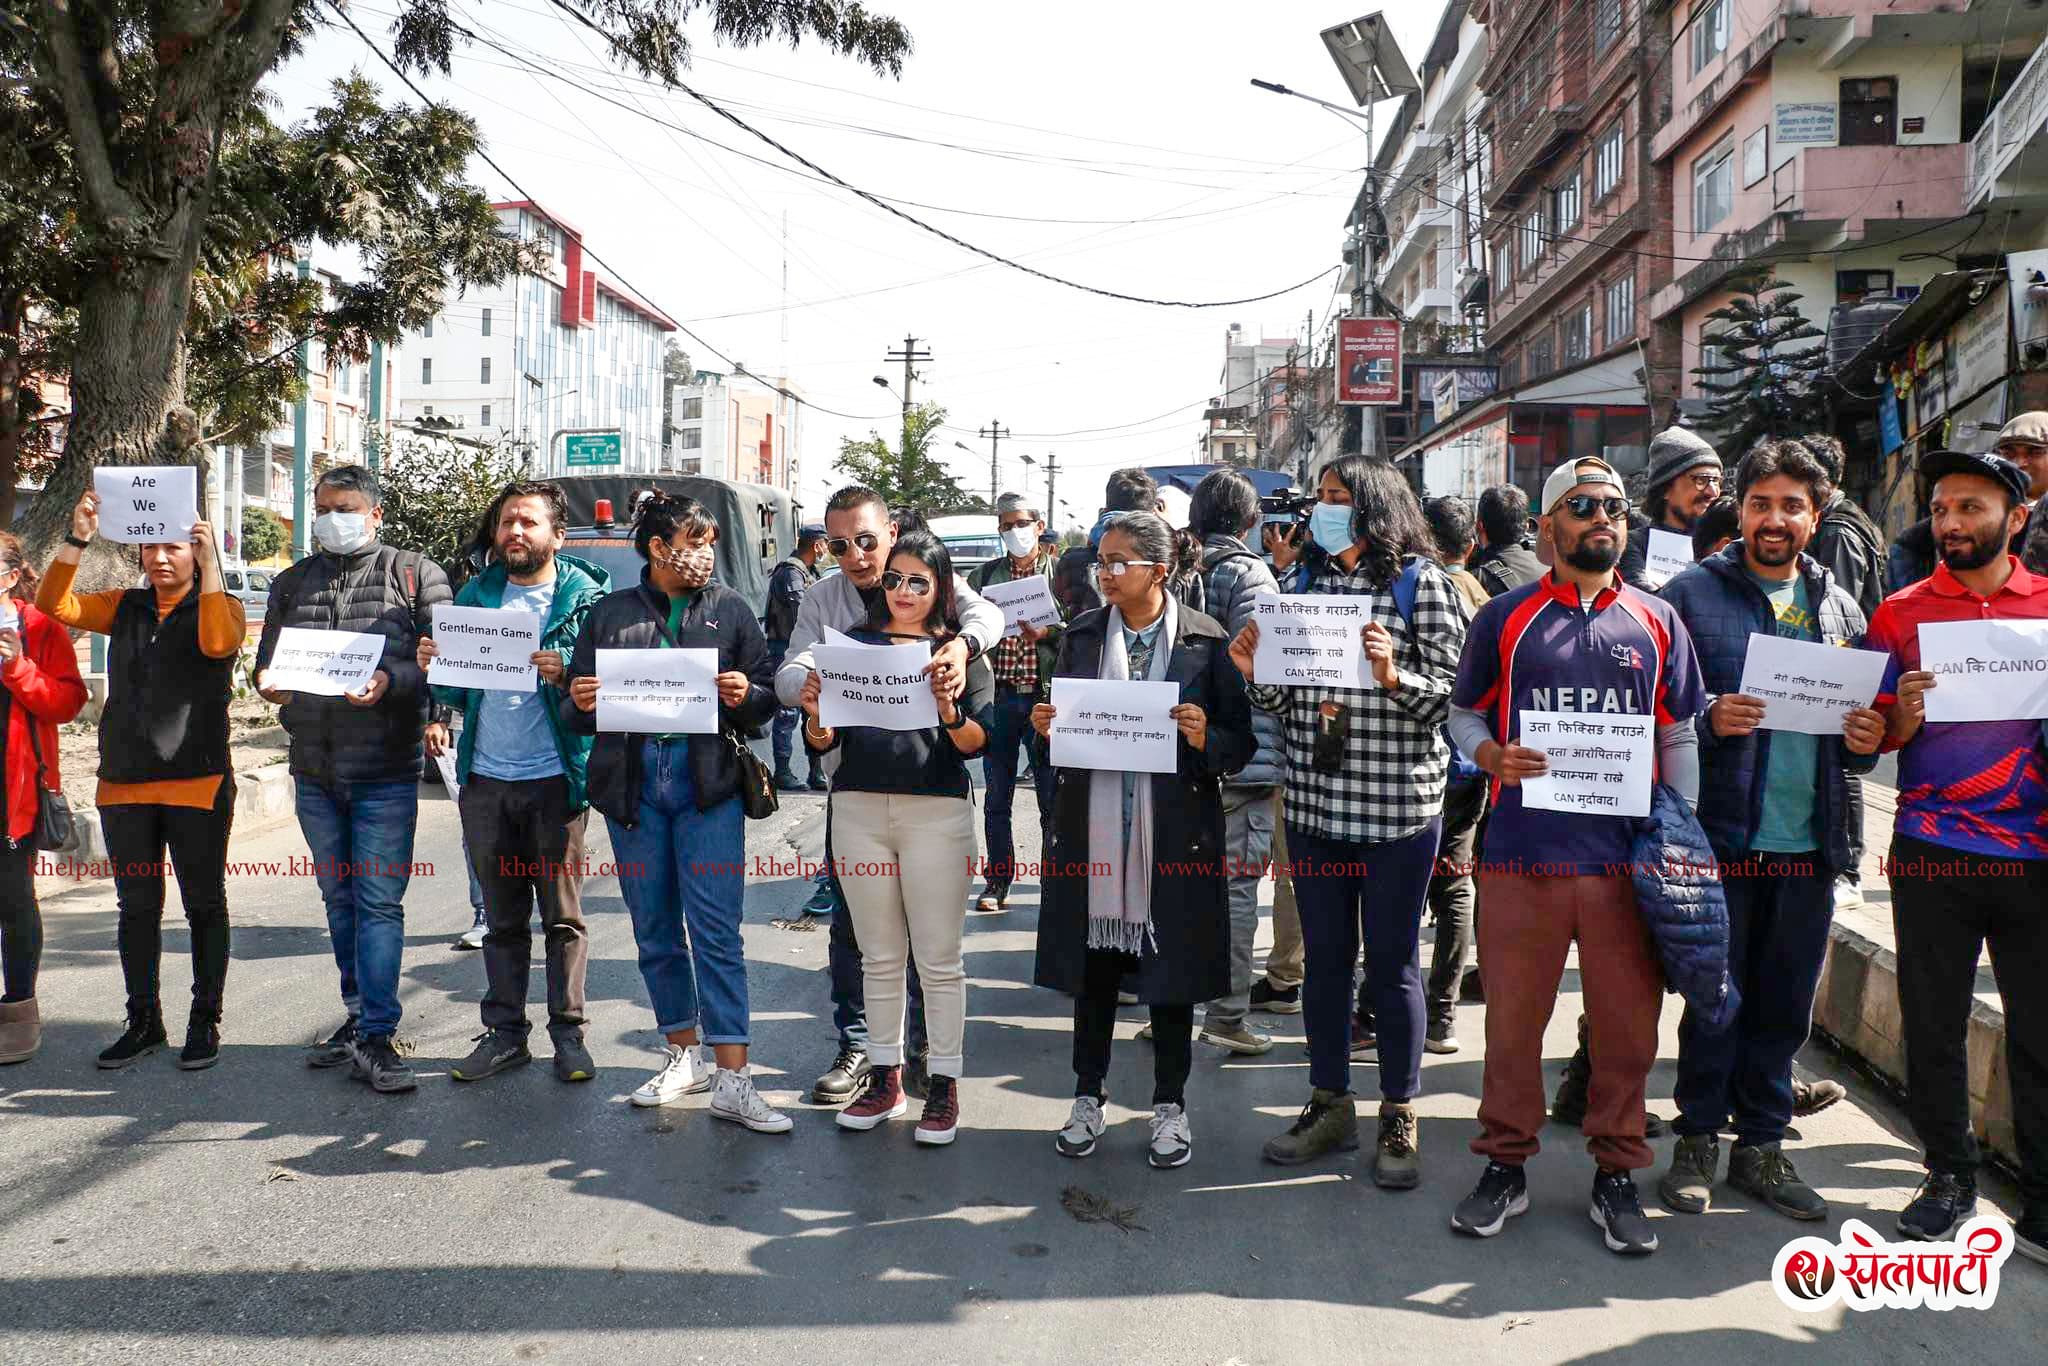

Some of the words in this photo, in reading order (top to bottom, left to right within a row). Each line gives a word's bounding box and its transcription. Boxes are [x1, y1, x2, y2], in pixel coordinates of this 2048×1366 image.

[132, 476, 156, 488] Are
[133, 499, 156, 511] We
[127, 523, 154, 535] safe
[159, 523, 165, 535] ?
[1025, 591, 1045, 602] Game
[1259, 604, 1275, 615] उता
[1030, 614, 1050, 623] Game
[439, 622, 498, 636] Gentleman
[501, 627, 533, 639] Game
[1274, 627, 1291, 636] यता
[1296, 626, 1347, 638] आरोपितलाई
[480, 646, 491, 654] or
[436, 657, 493, 672] Mentalman
[496, 663, 525, 674] Game
[1932, 663, 1963, 674] CAN
[1966, 658, 1987, 673] कि
[1988, 660, 2048, 672] CANNO
[821, 669, 869, 685] Sandeep
[872, 675, 882, 685] &
[885, 673, 927, 686] Chatur
[1285, 668, 1304, 677] CAN
[624, 679, 636, 687] मेरो
[664, 679, 685, 688] टिममा
[1774, 673, 1788, 682] मेरो
[1820, 680, 1843, 690] टिममा
[842, 689, 863, 701] 420
[865, 694, 886, 704] not
[888, 695, 910, 704] out
[1532, 688, 1639, 714] NEPAL
[1078, 712, 1091, 720] मेरो
[1121, 713, 1143, 722] टिममा
[1529, 722, 1550, 732] उता
[1547, 748, 1566, 757] यता
[1572, 747, 1632, 762] आरोपितलाई
[1551, 769, 1597, 782] क्याम्पमा
[1554, 793, 1574, 803] CAN
